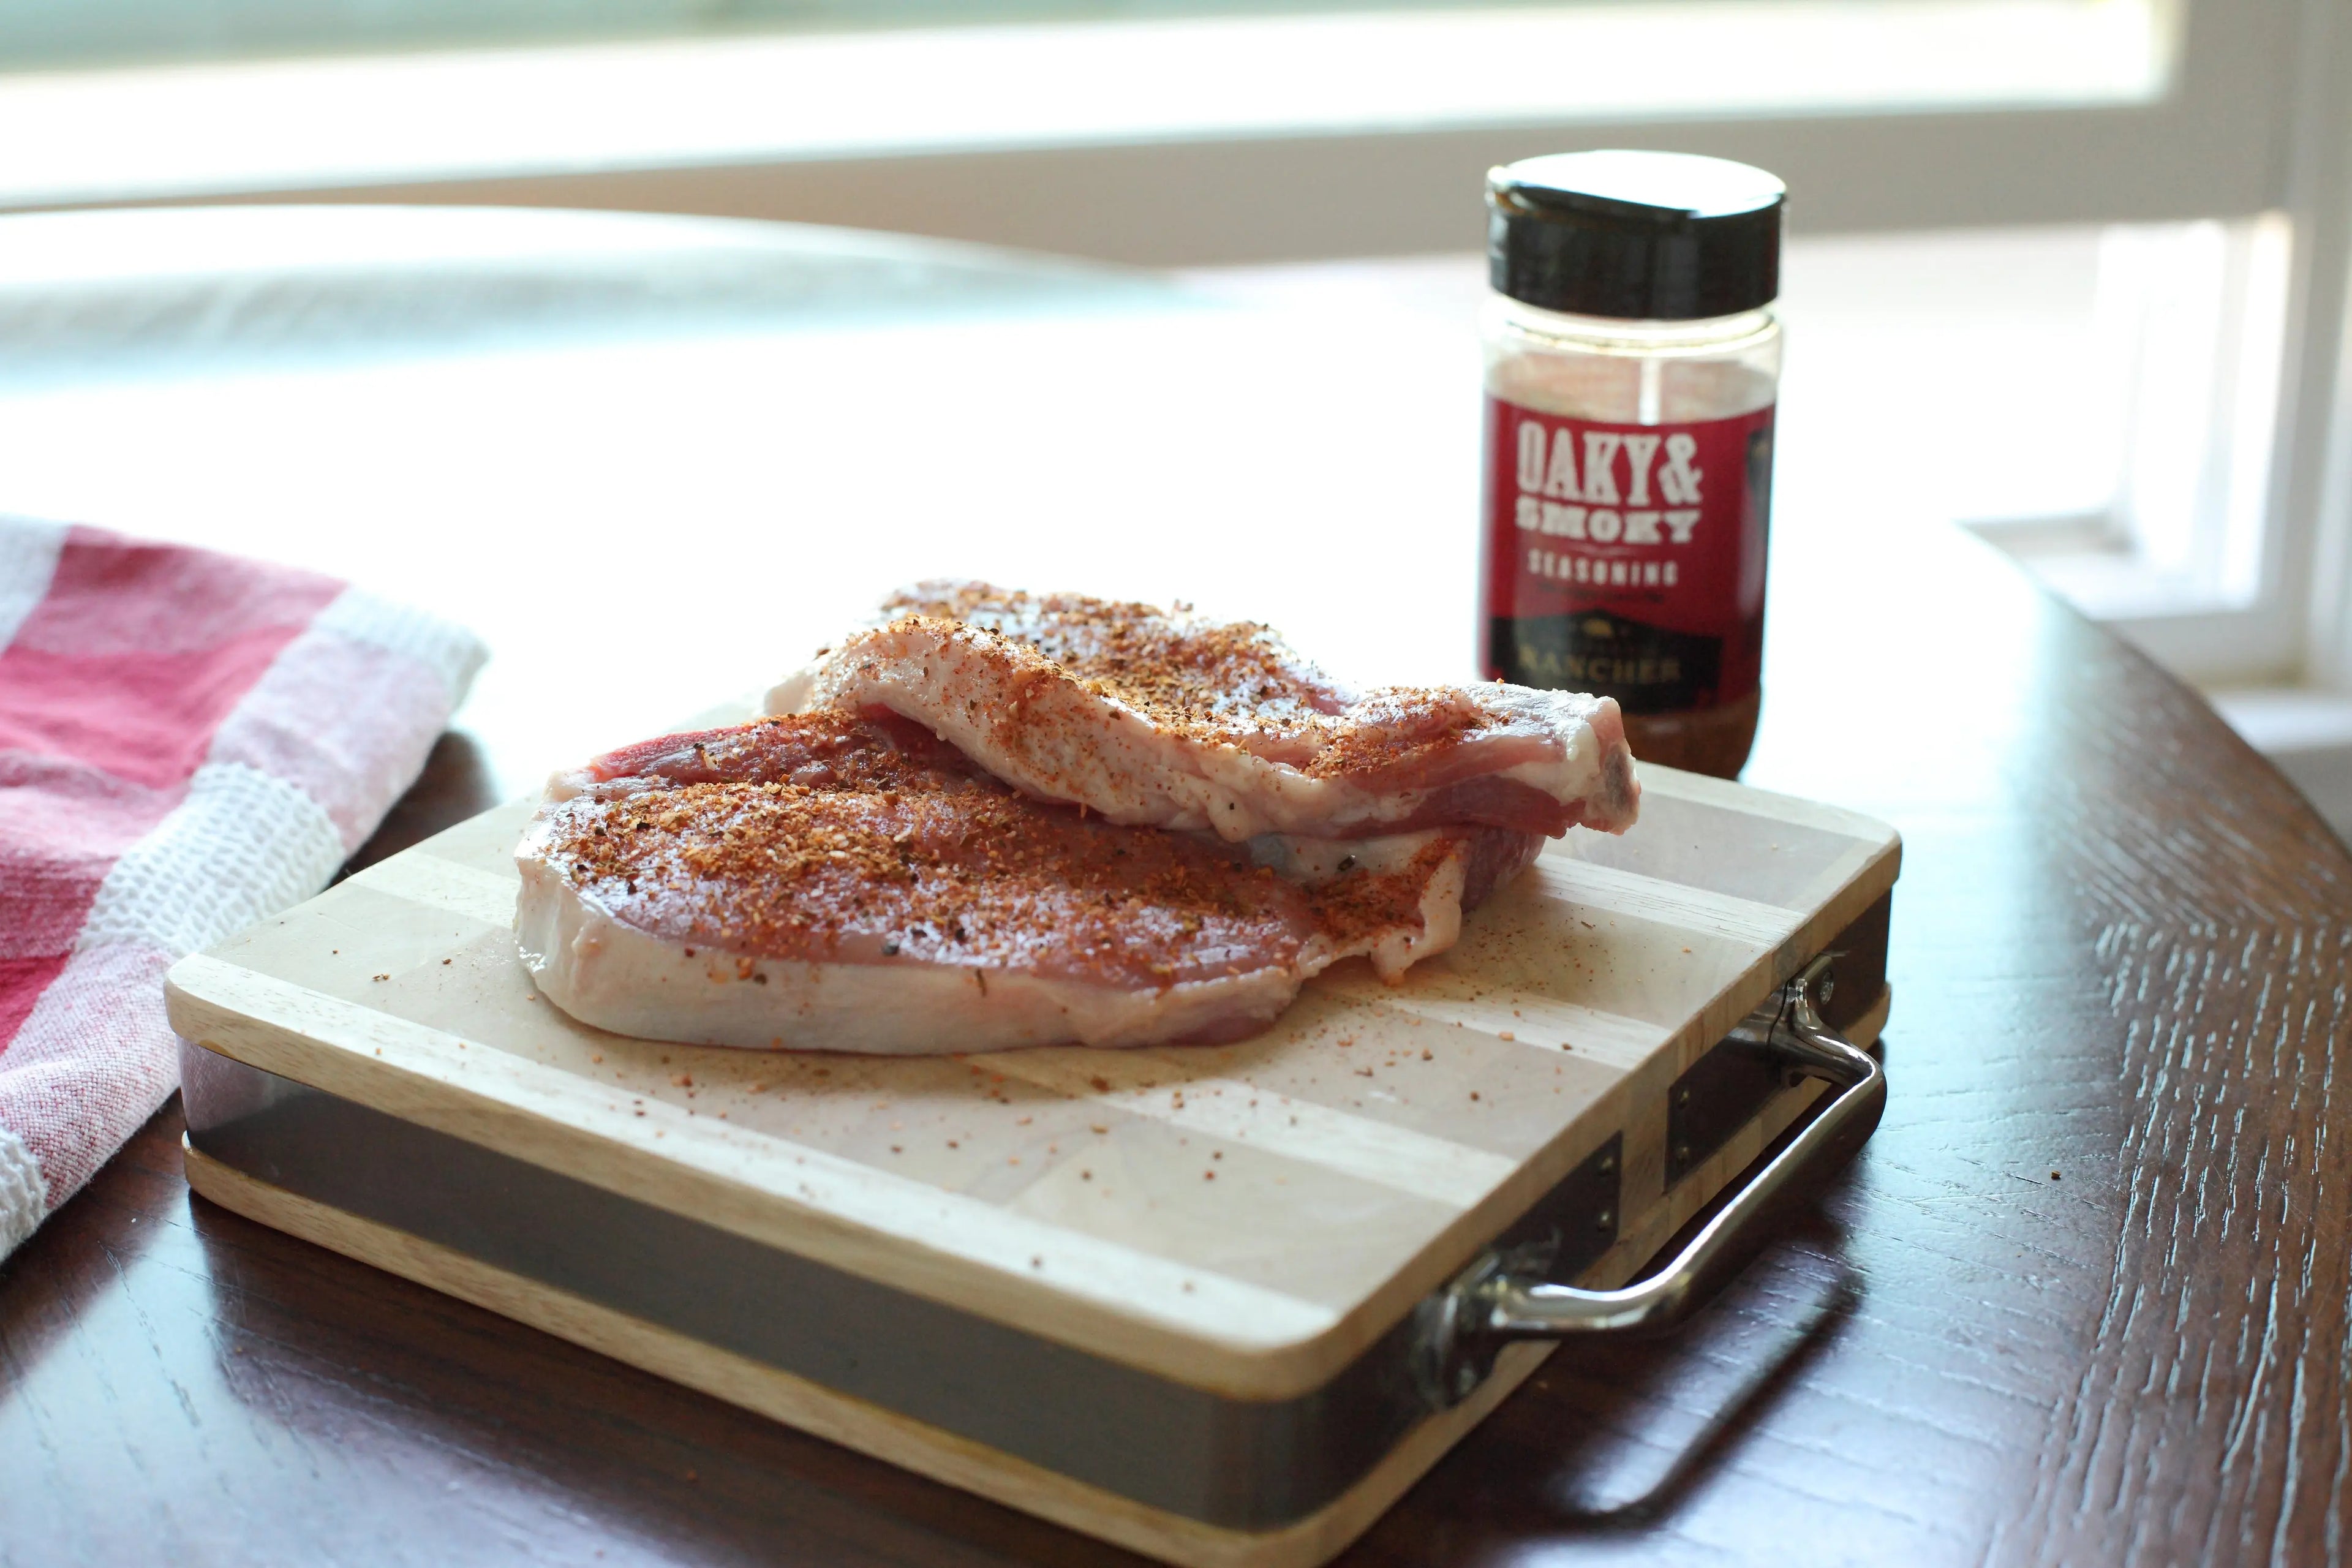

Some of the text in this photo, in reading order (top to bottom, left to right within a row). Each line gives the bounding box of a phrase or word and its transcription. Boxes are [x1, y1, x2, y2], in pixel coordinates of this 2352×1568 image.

[1517, 421, 1703, 506] OAKY&
[1515, 494, 1700, 543] SMOKY
[1528, 549, 1678, 586] SEASONING
